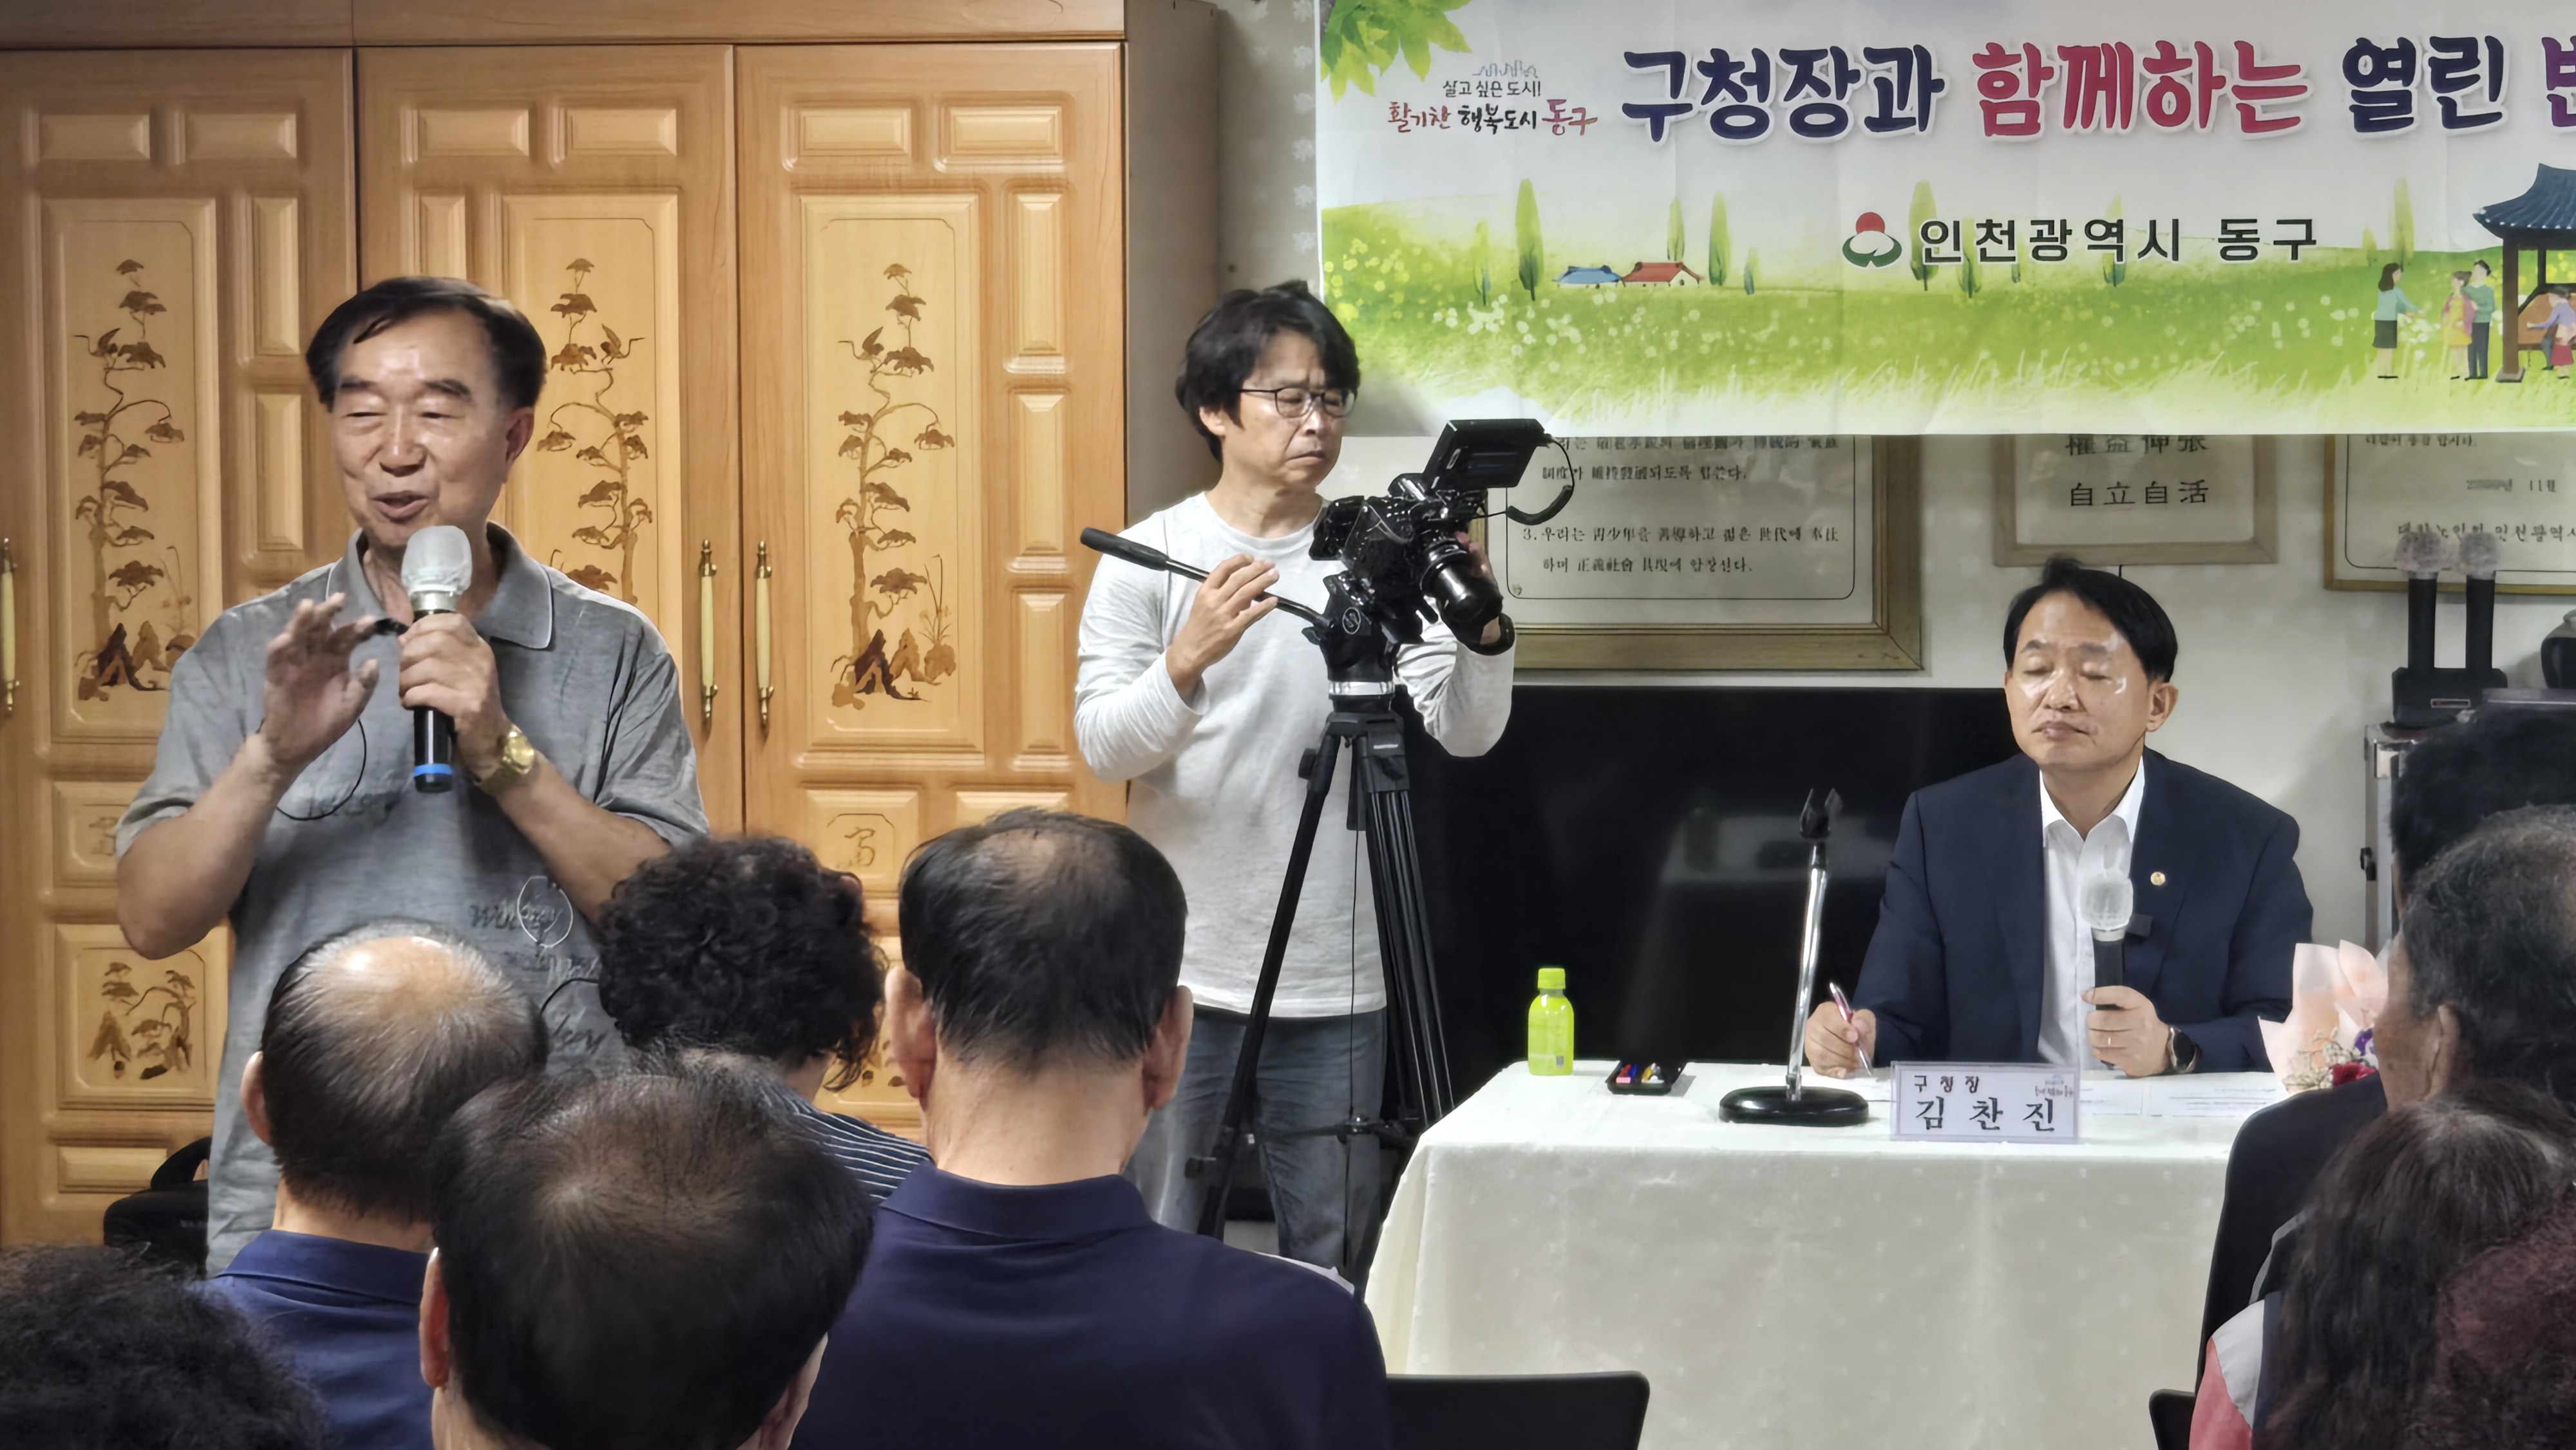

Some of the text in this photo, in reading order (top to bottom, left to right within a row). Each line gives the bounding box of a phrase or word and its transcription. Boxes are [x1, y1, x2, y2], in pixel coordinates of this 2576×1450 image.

[1443, 80, 1541, 98] 살고 싶은 도시!
[1622, 44, 1946, 142] 구청장과
[1972, 39, 2309, 137] 함께하는
[2342, 35, 2503, 133] 열린
[1388, 99, 1598, 136] 활기찬 행복도시 동구
[1920, 218, 2318, 263] 인천광역시 동구
[2070, 479, 2209, 507] 自立自活
[1542, 527, 1586, 542] 우리는
[1915, 1096, 2055, 1131] 김찬진
